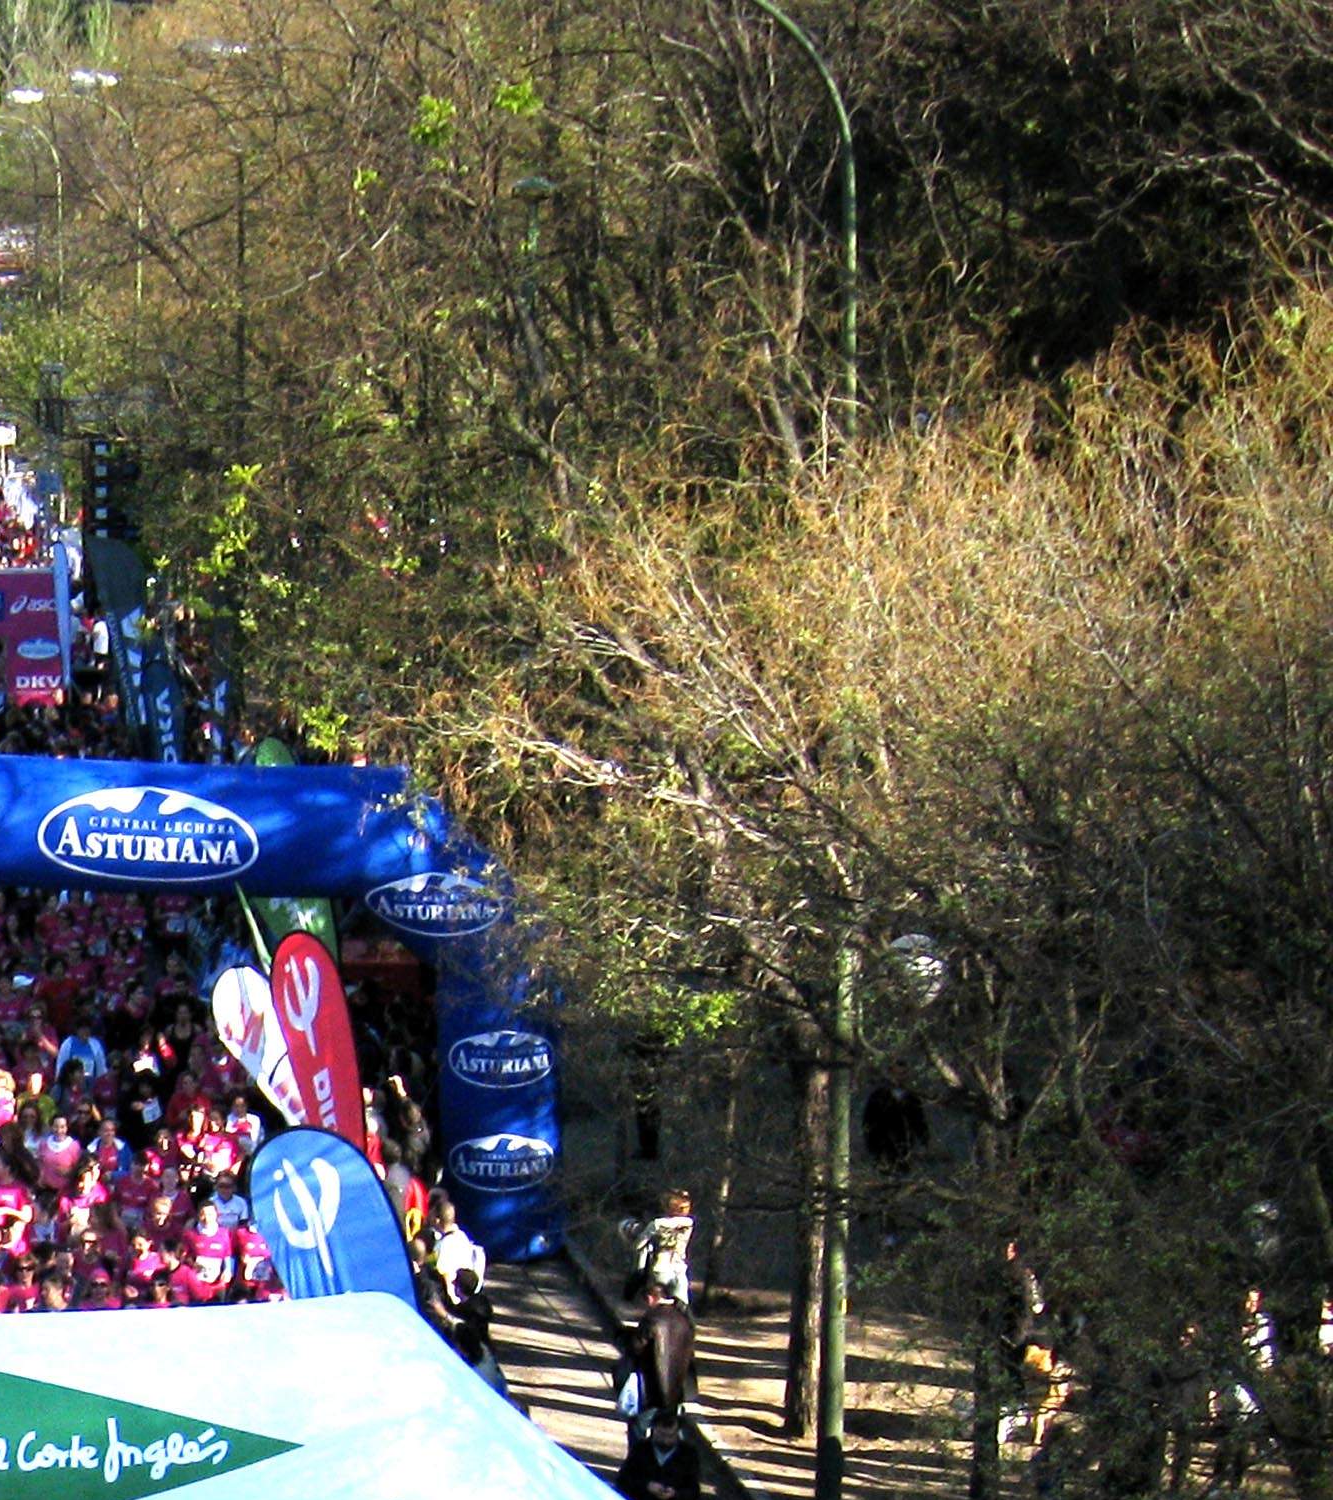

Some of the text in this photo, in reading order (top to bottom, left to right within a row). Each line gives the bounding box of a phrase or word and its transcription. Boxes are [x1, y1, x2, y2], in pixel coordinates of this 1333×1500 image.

[16, 676, 61, 688] DKV
[89, 816, 158, 831] CENTRAL
[55, 817, 240, 866] ASTURIANA
[454, 1050, 549, 1075] ASTURIANA
[455, 1153, 547, 1176] ASTURIANA
[18, 1431, 100, 1473] Corte
[104, 1418, 226, 1483] Inglés
